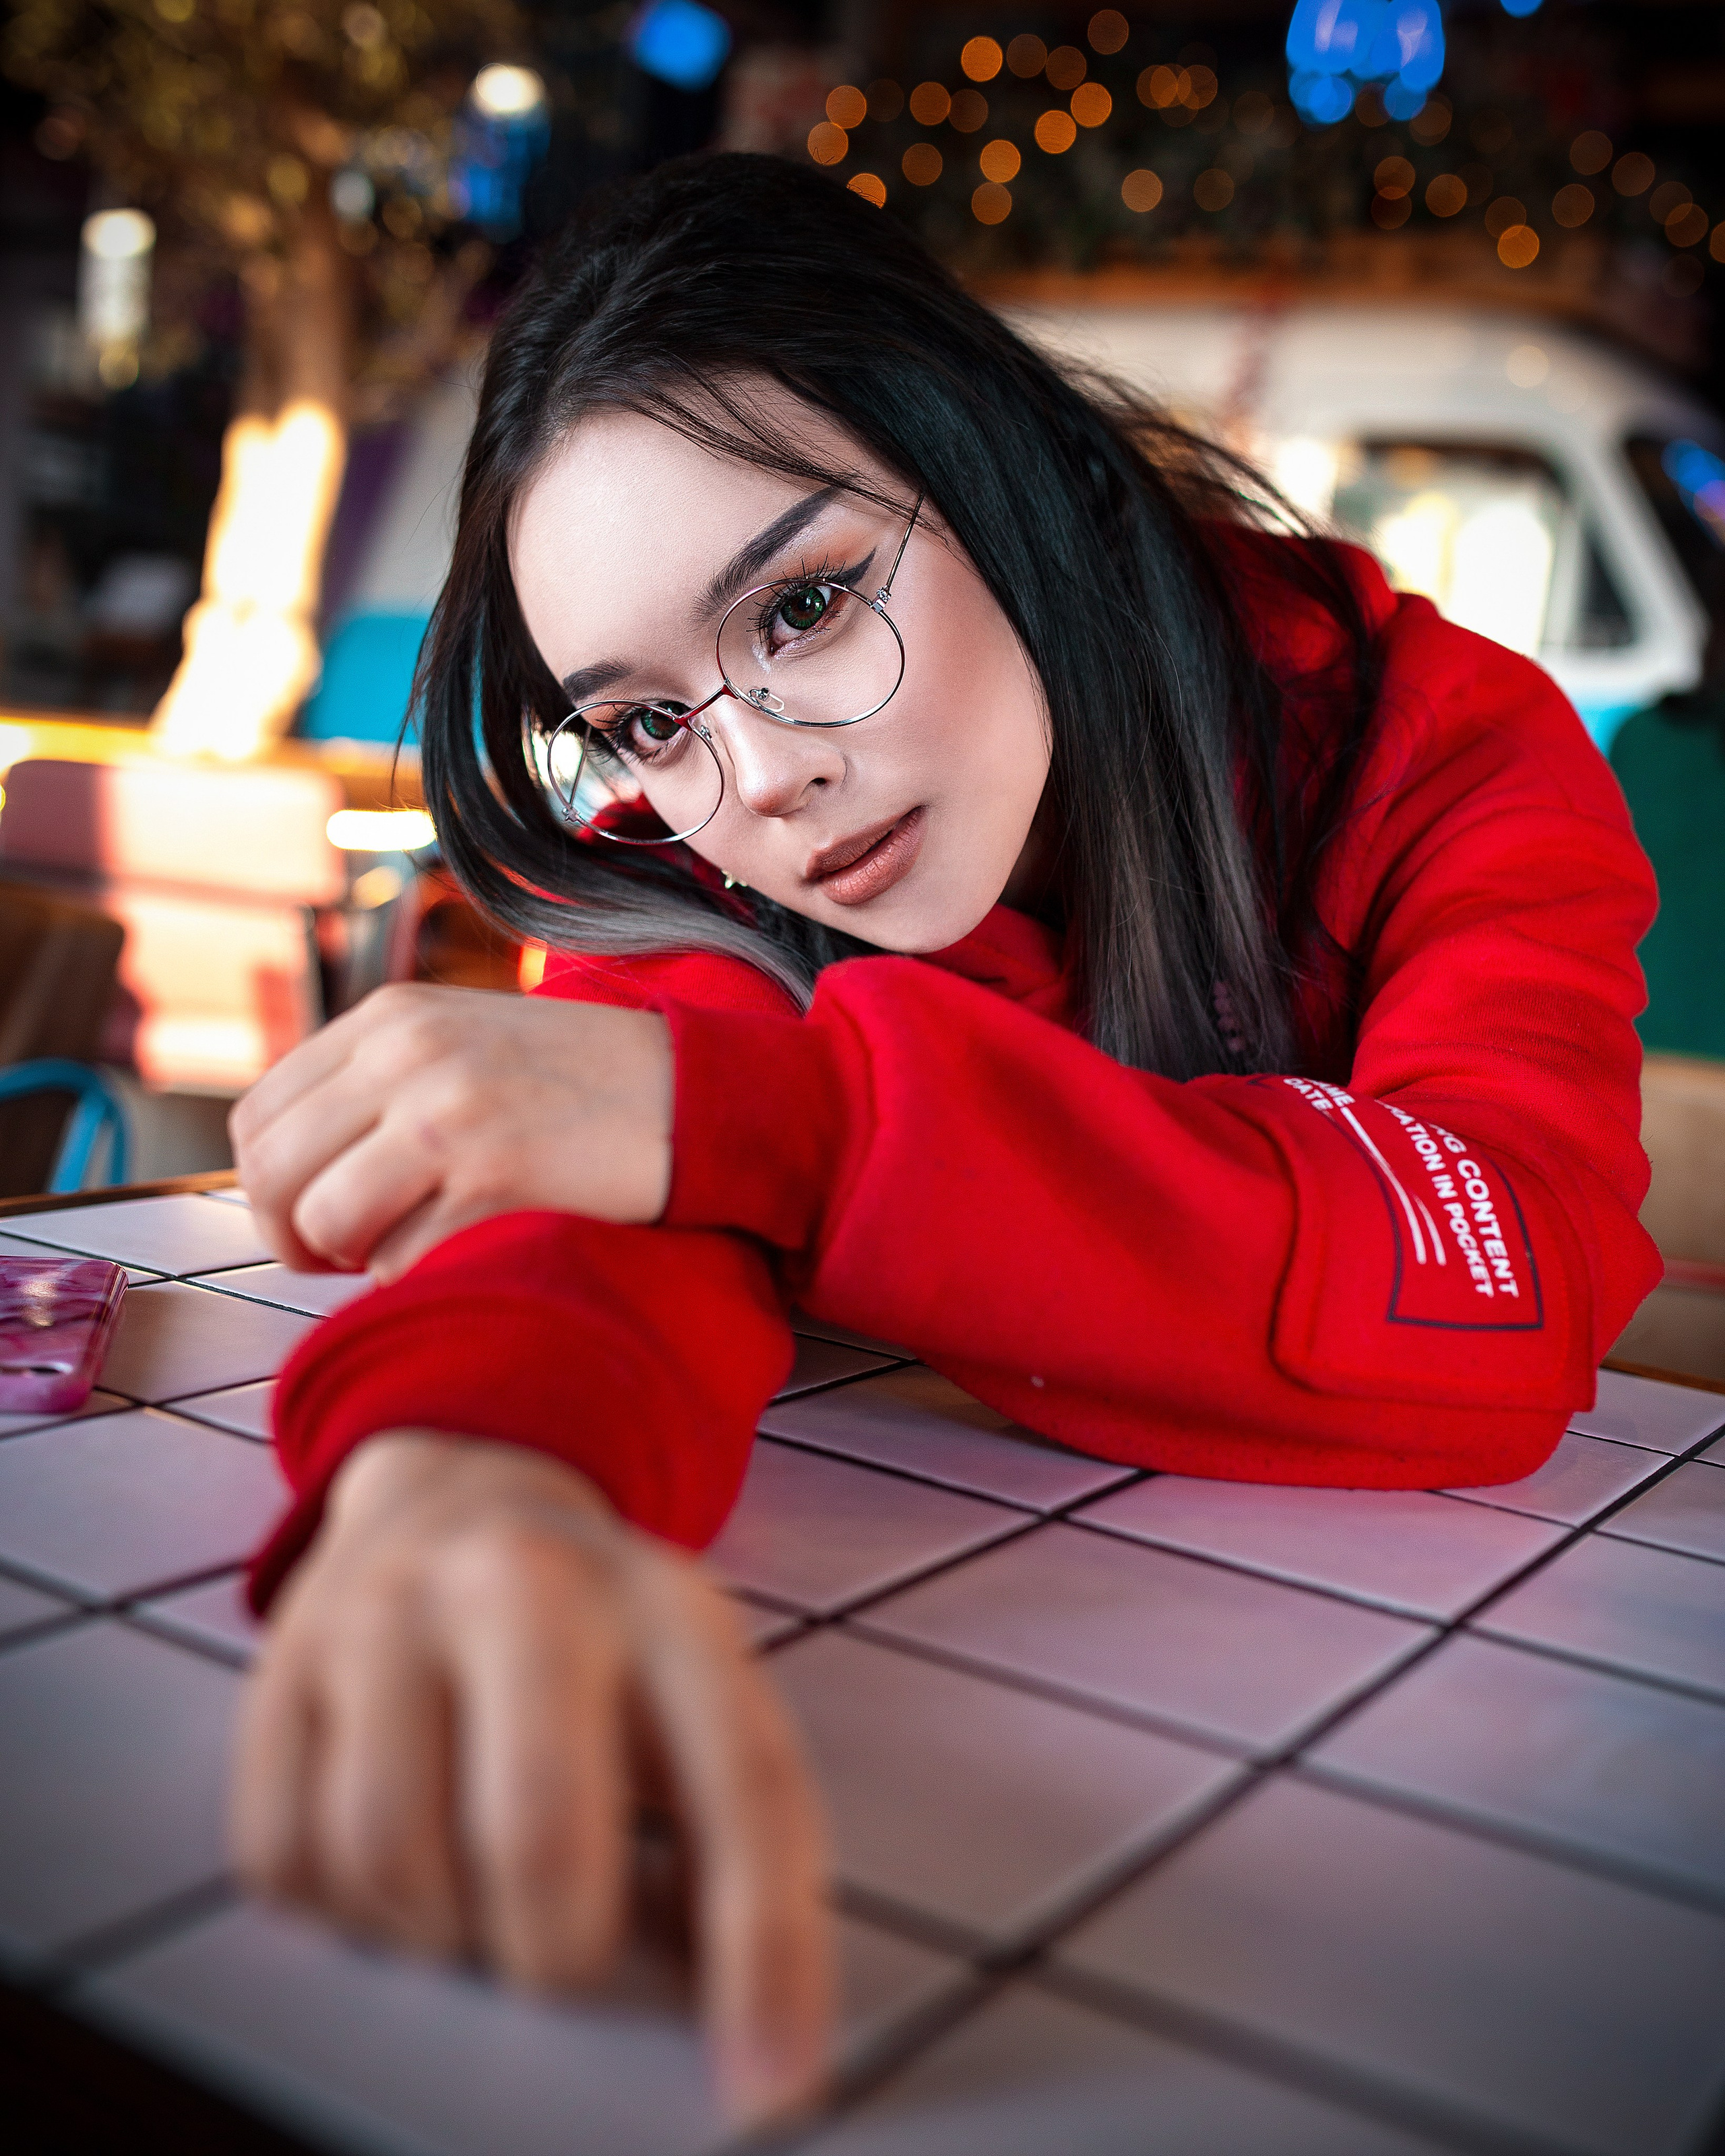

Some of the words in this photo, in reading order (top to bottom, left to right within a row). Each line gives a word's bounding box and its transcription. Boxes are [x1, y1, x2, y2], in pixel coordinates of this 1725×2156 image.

[1431, 1174, 1458, 1199] IN
[1456, 1159, 1520, 1298] CONTENT
[1443, 1201, 1495, 1298] POCKET
